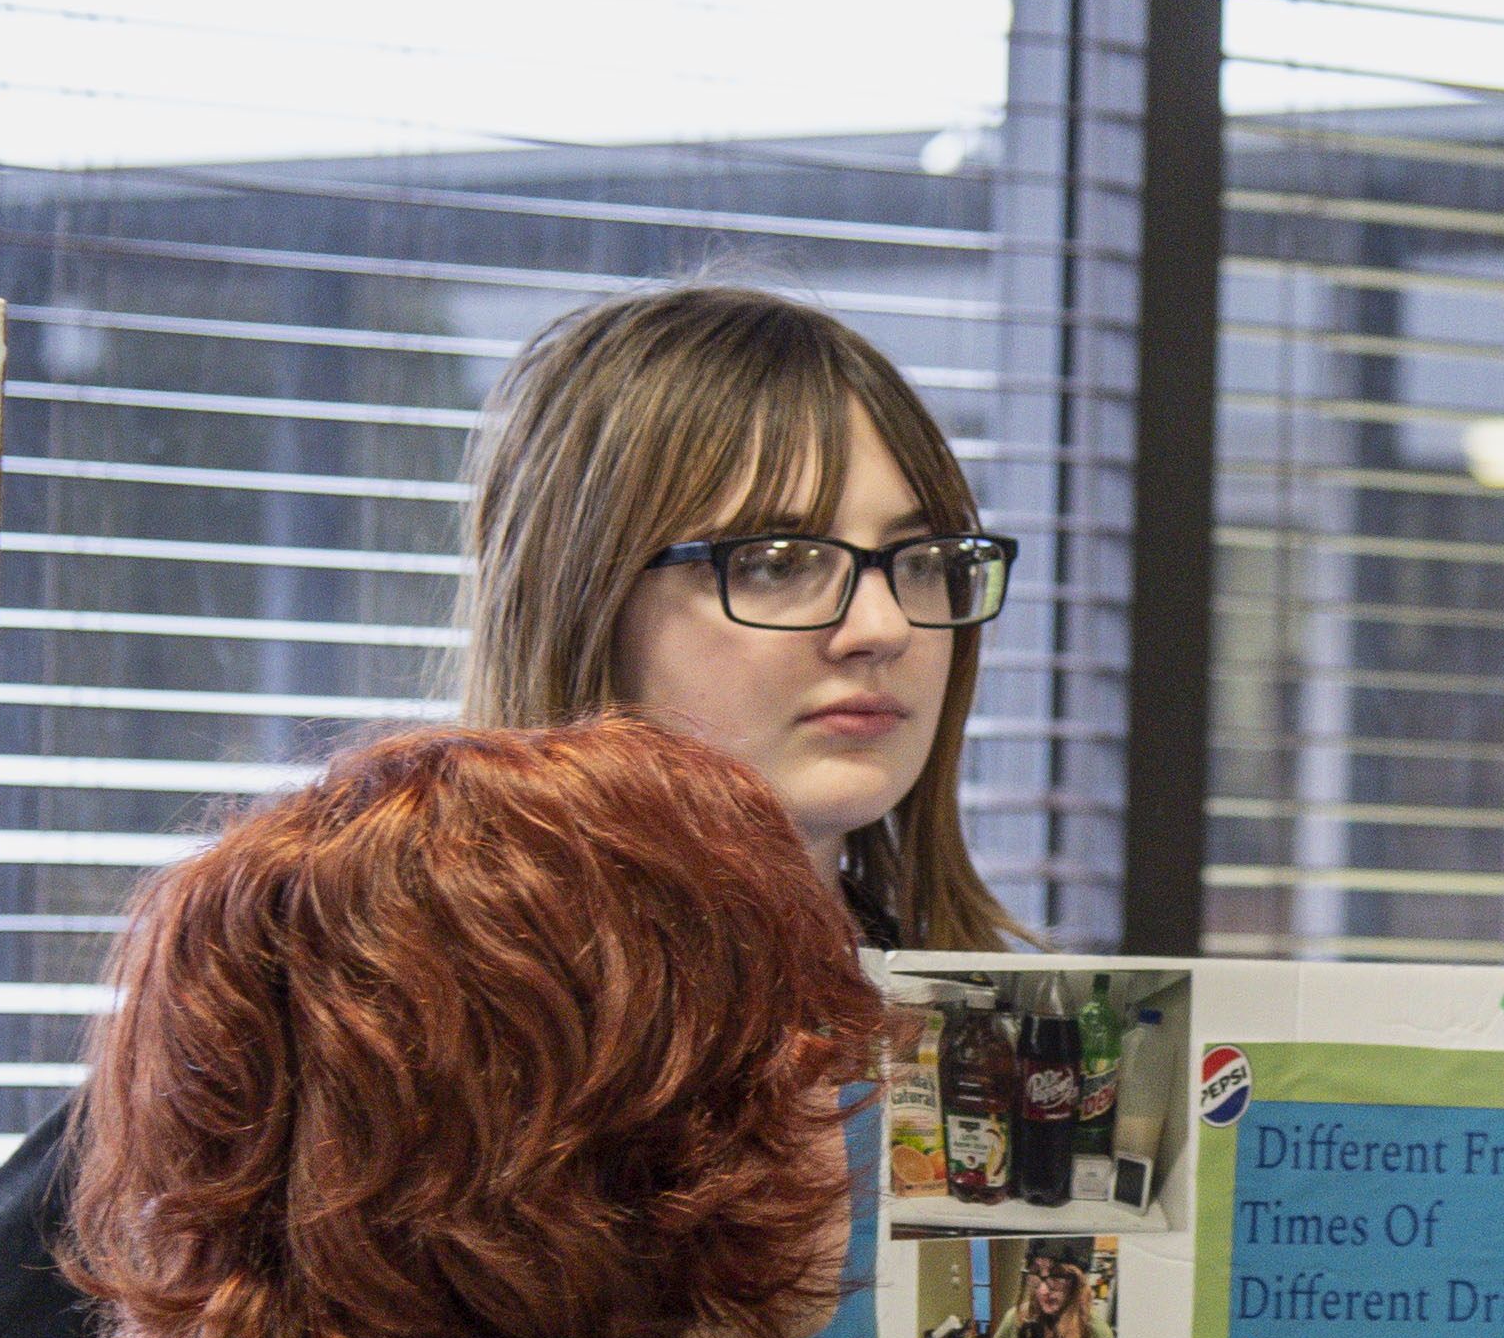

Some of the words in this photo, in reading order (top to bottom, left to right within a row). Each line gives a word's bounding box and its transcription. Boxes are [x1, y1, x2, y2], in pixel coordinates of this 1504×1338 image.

[1253, 1123, 1447, 1173] Different
[1239, 1200, 1369, 1247] Times
[1384, 1201, 1445, 1249] Of
[1235, 1272, 1430, 1323] Different
